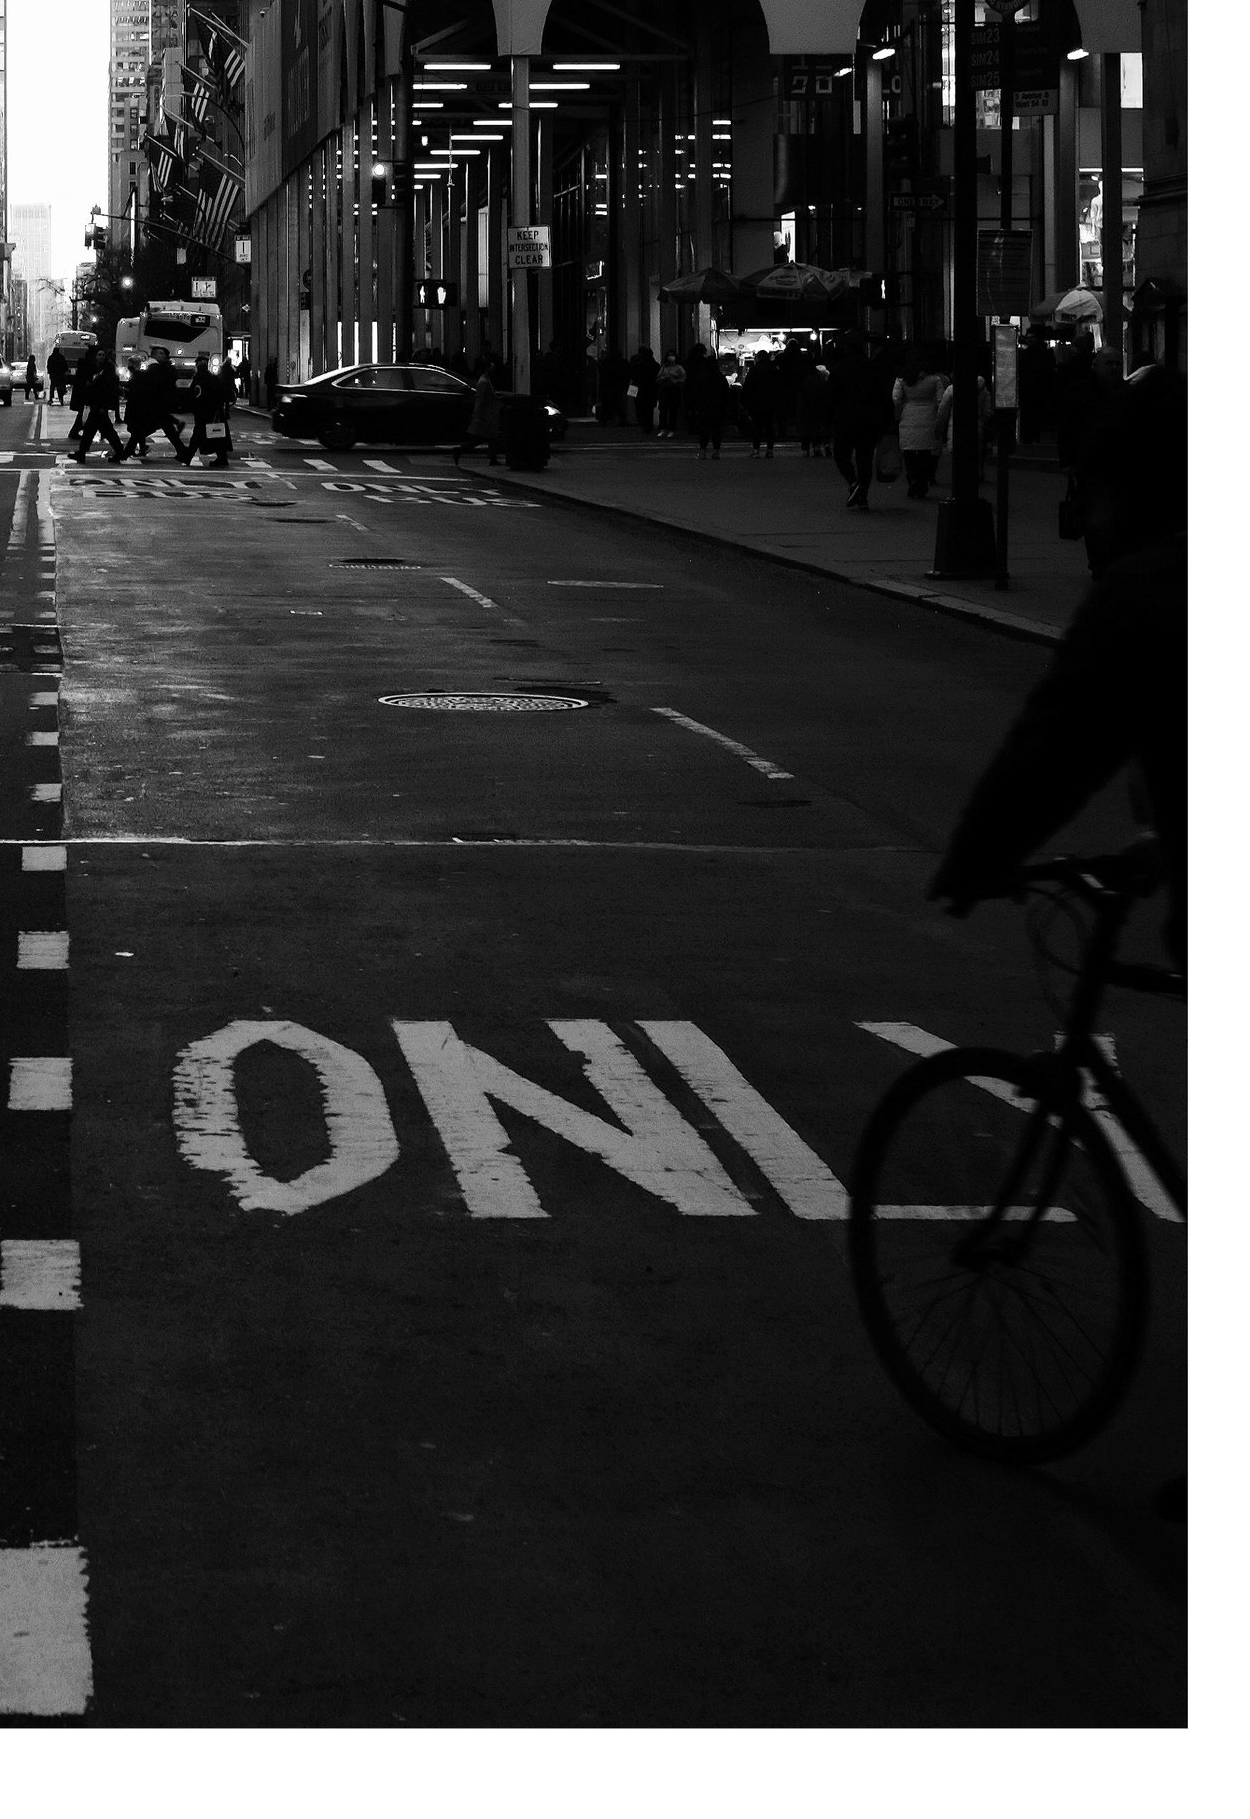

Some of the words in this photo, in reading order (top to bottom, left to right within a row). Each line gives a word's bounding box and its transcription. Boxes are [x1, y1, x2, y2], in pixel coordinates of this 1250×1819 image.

[971, 49, 1000, 67] SIM24
[971, 71, 1000, 89] SIM25
[516, 230, 539, 240] KEEP
[515, 254, 544, 265] CLEAR
[320, 482, 502, 496] ONLY
[173, 1018, 1187, 1221] ONLY
